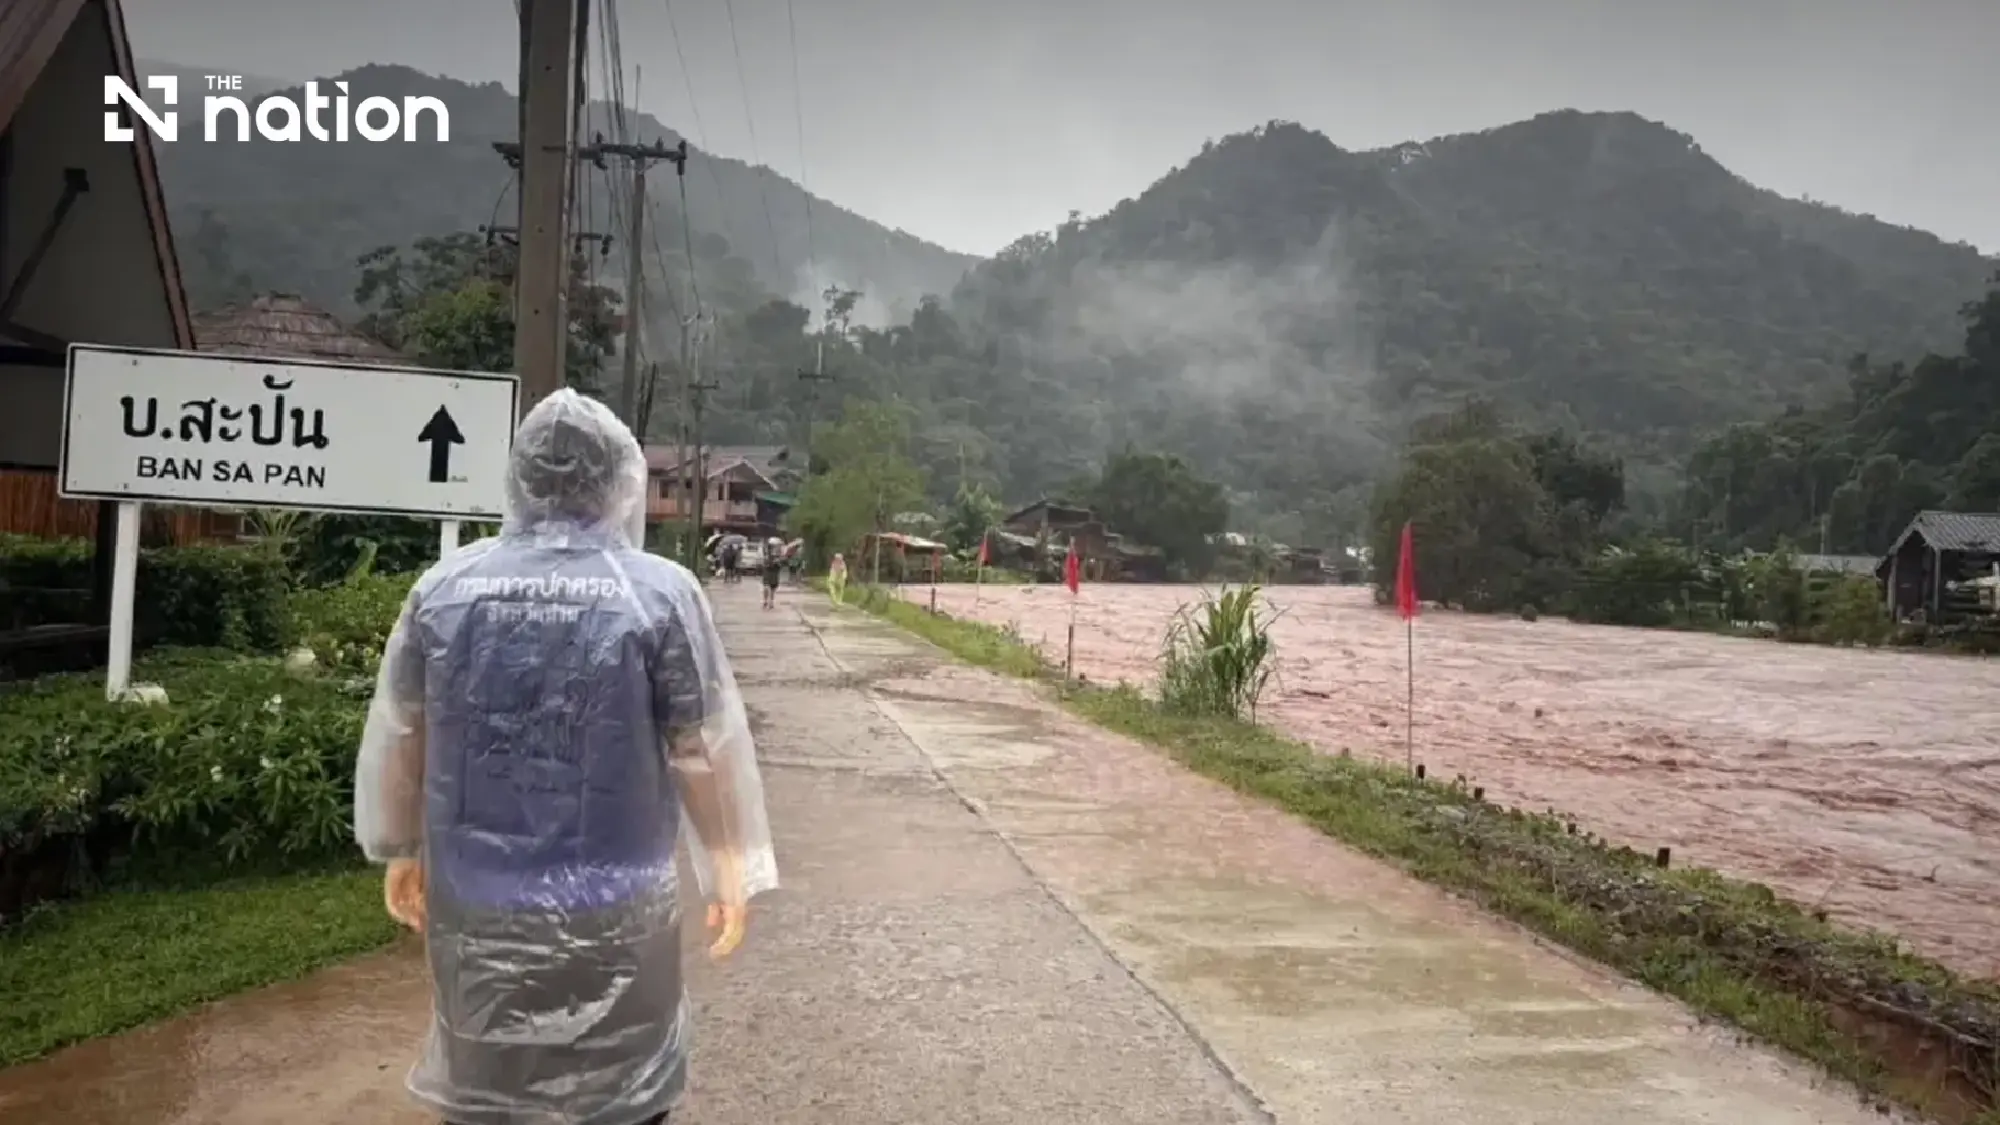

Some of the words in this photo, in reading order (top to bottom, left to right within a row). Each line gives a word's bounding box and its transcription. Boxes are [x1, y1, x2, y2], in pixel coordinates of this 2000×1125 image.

[120, 374, 330, 450] บ.สะปัน
[137, 456, 203, 481] BAN
[212, 460, 254, 484] SA
[264, 464, 326, 489] PAN
